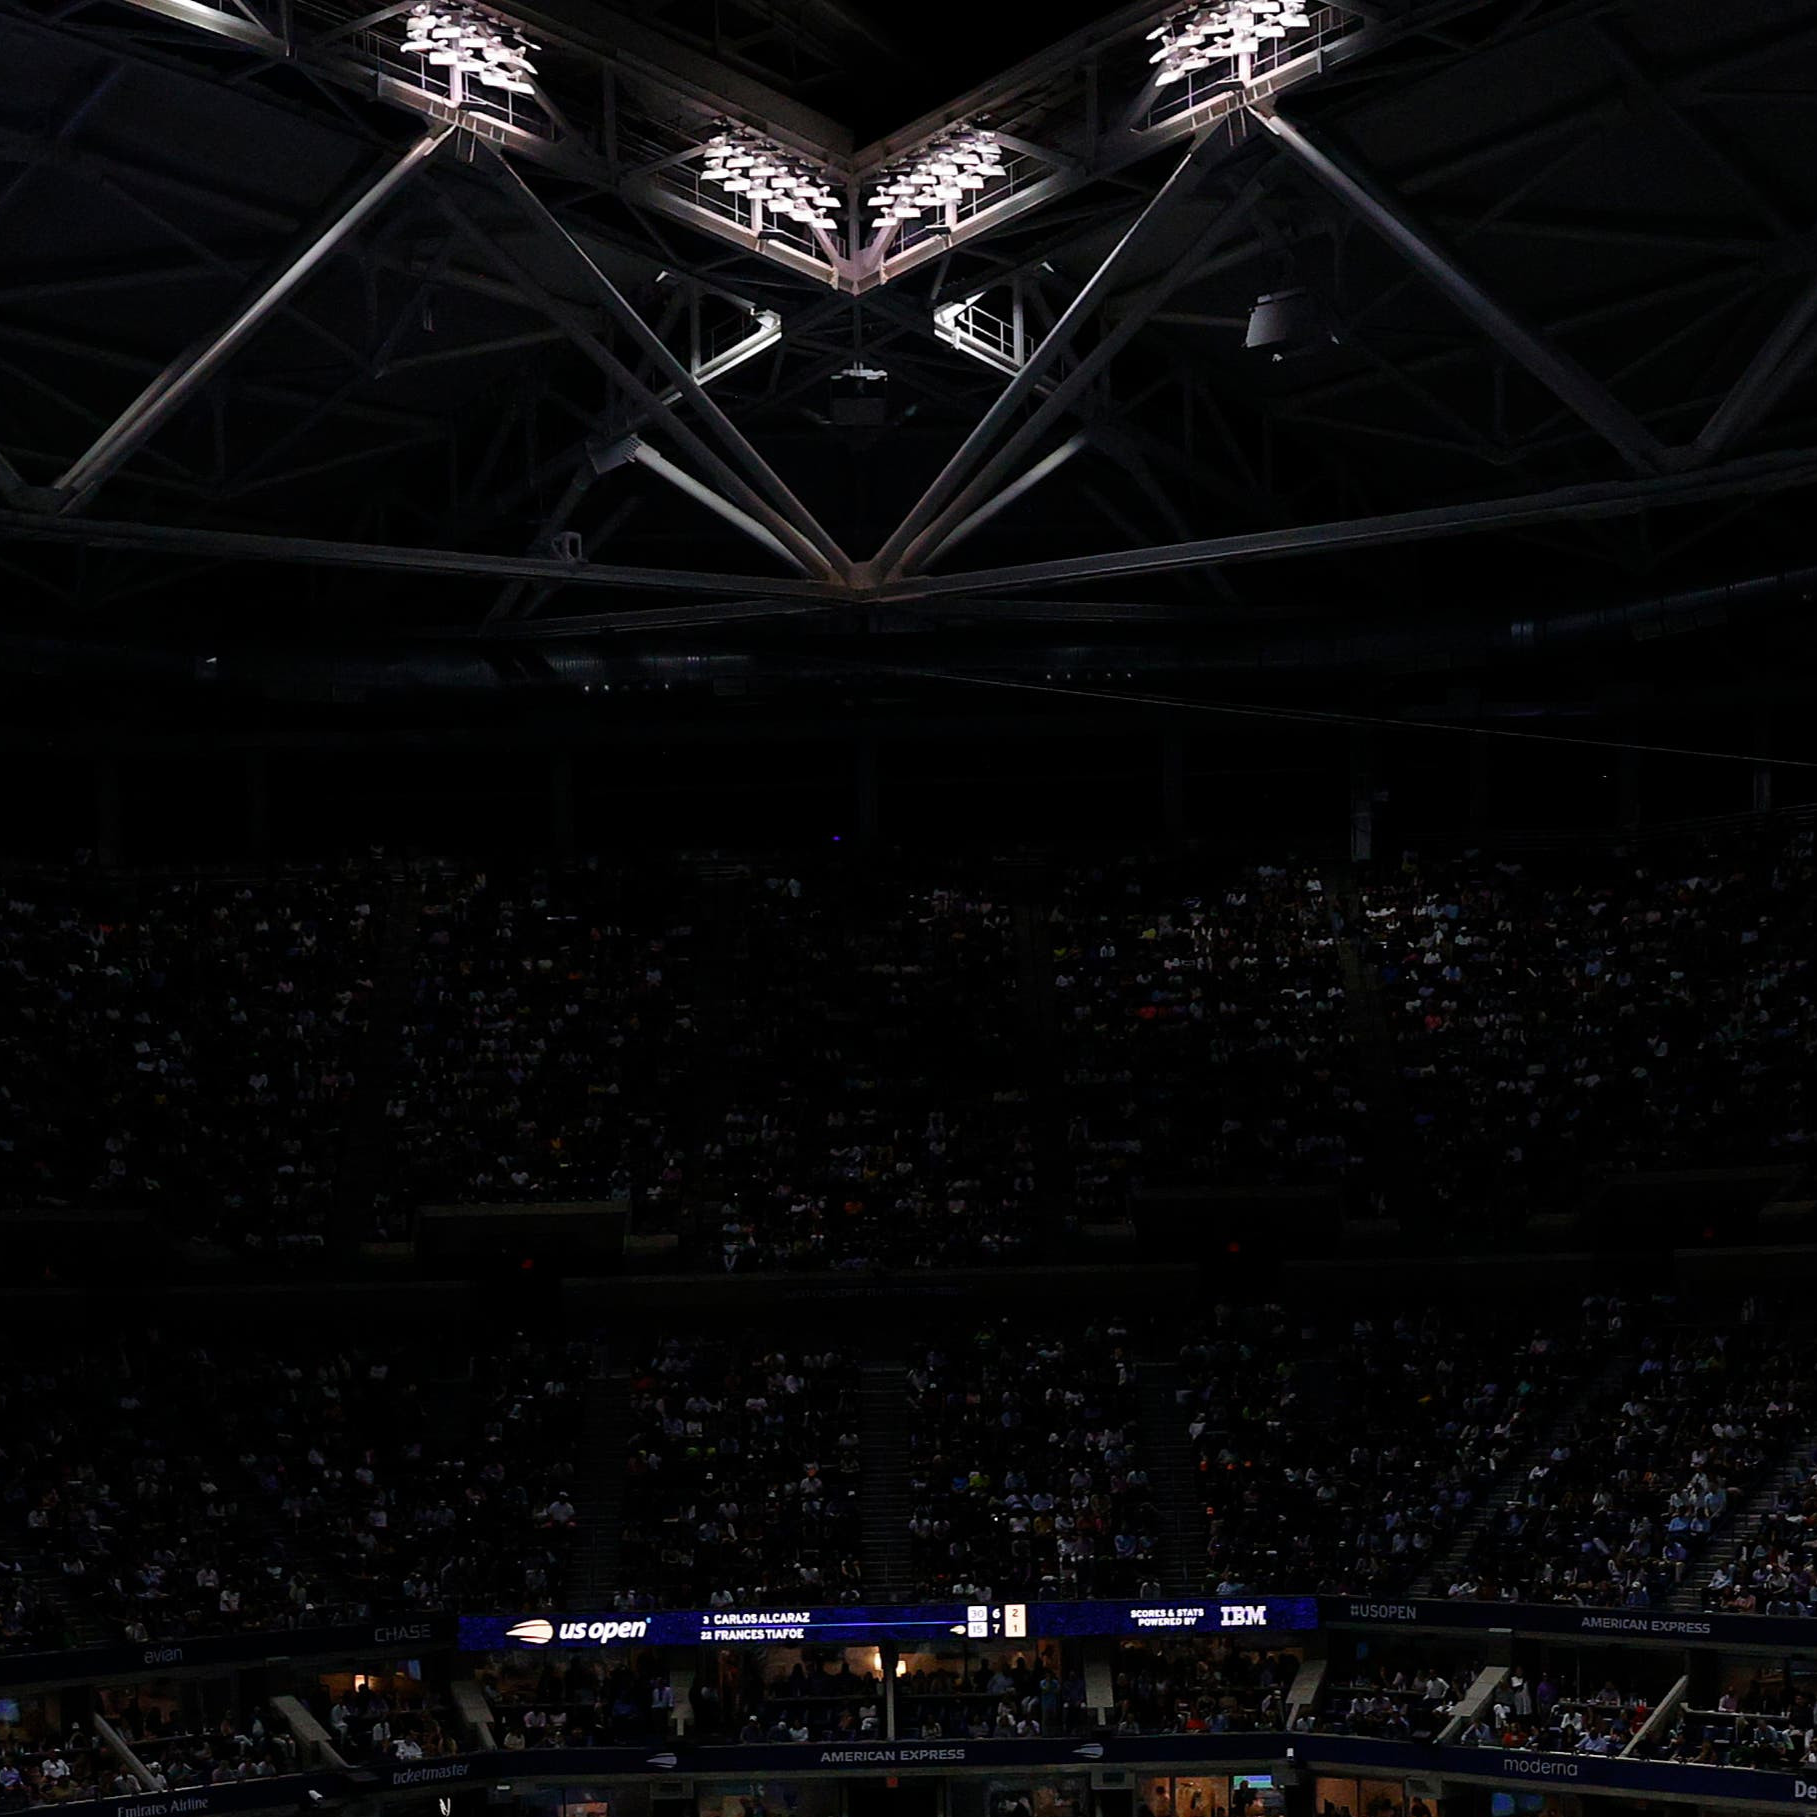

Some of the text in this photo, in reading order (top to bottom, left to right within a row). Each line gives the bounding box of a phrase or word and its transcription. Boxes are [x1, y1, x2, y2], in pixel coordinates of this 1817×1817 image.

[714, 1614, 757, 1624] CARLOS
[758, 1613, 810, 1624] ALCARAZ
[992, 1608, 1000, 1618] 6
[1012, 1609, 1018, 1617] 2
[1177, 1608, 1204, 1617] STATS
[1221, 1606, 1266, 1626] IBM
[1350, 1604, 1416, 1620] #USOPEN
[993, 1624, 1000, 1633] 7
[1138, 1618, 1181, 1626] POWERED
[1581, 1616, 1711, 1635] AMERICAN EXPRESS
[374, 1622, 431, 1644] CHASE
[560, 1618, 646, 1643] us open
[701, 1629, 804, 1640] 22 FRANCES TIAFOE
[821, 1747, 966, 1763] AMERICAN EXPRESS
[392, 1762, 470, 1785] ticketmaster
[1503, 1758, 1578, 1777] moderna
[167, 1795, 209, 1814] Airline
